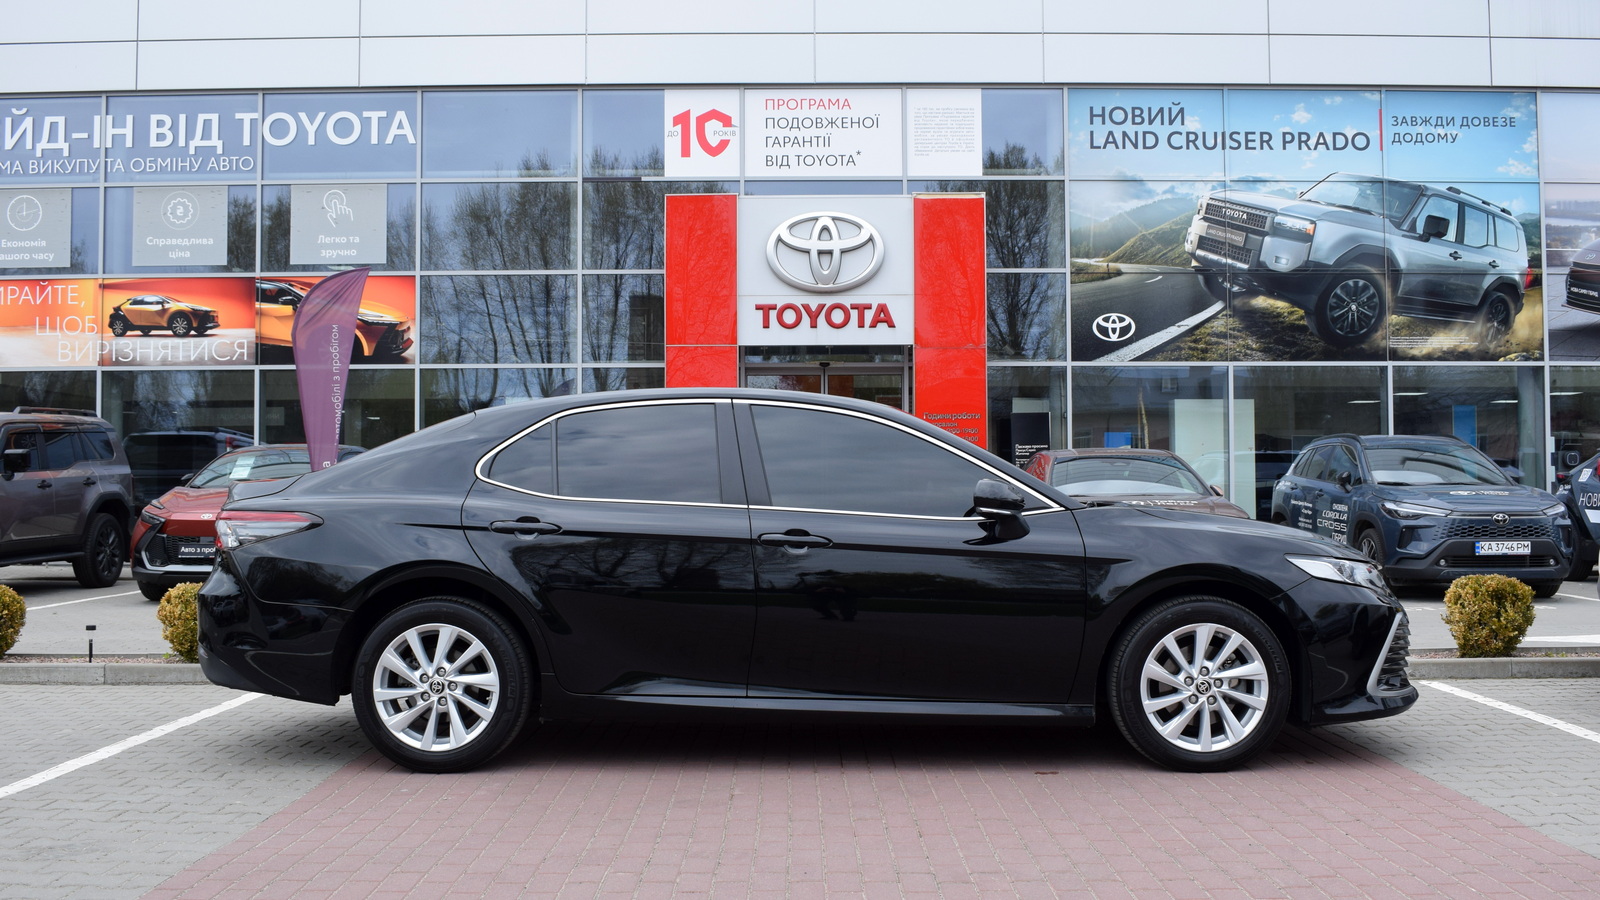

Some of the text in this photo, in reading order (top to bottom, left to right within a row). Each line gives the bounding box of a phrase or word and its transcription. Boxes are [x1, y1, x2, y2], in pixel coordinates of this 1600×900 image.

[765, 98, 852, 110] ПРОГРАМА
[1089, 101, 1185, 126] НОВИЙ
[765, 113, 881, 131] ПОДОВЖЕНОЇ
[1391, 115, 1517, 130] ЗАВЖДИ ДОВЕЗЕ
[149, 113, 224, 155] ВІД
[234, 110, 417, 147] TOYOTA
[667, 130, 679, 138] ДО
[1391, 132, 1459, 146] ДОДОМУ
[765, 132, 832, 148] ГАРАНТІЇ
[1089, 130, 1371, 151] LAND CRUISER PRADO
[28, 158, 101, 175] ВИКУПУ
[104, 158, 125, 173] ТА
[130, 157, 203, 173] ОБМІНУ
[206, 156, 254, 172] АВТО
[765, 154, 791, 169] ВІД
[1222, 208, 1247, 220] TOYOTA
[1, 238, 47, 248] Економія
[146, 236, 214, 247] Справедлива
[317, 234, 360, 244] Легко та
[32, 252, 55, 262] часу
[168, 248, 191, 259] ціна
[320, 248, 357, 258] зручно
[755, 302, 896, 329] TOYOTA
[35, 314, 98, 338] ЩОБ
[58, 338, 249, 362] ВИРІЗНЯТИСЯ
[330, 324, 341, 373] пробігом
[923, 411, 981, 421] Години роботи
[1322, 510, 1348, 521] COROLLA
[1316, 518, 1347, 532] CROSS
[1480, 542, 1530, 552] KA 3746 PM
